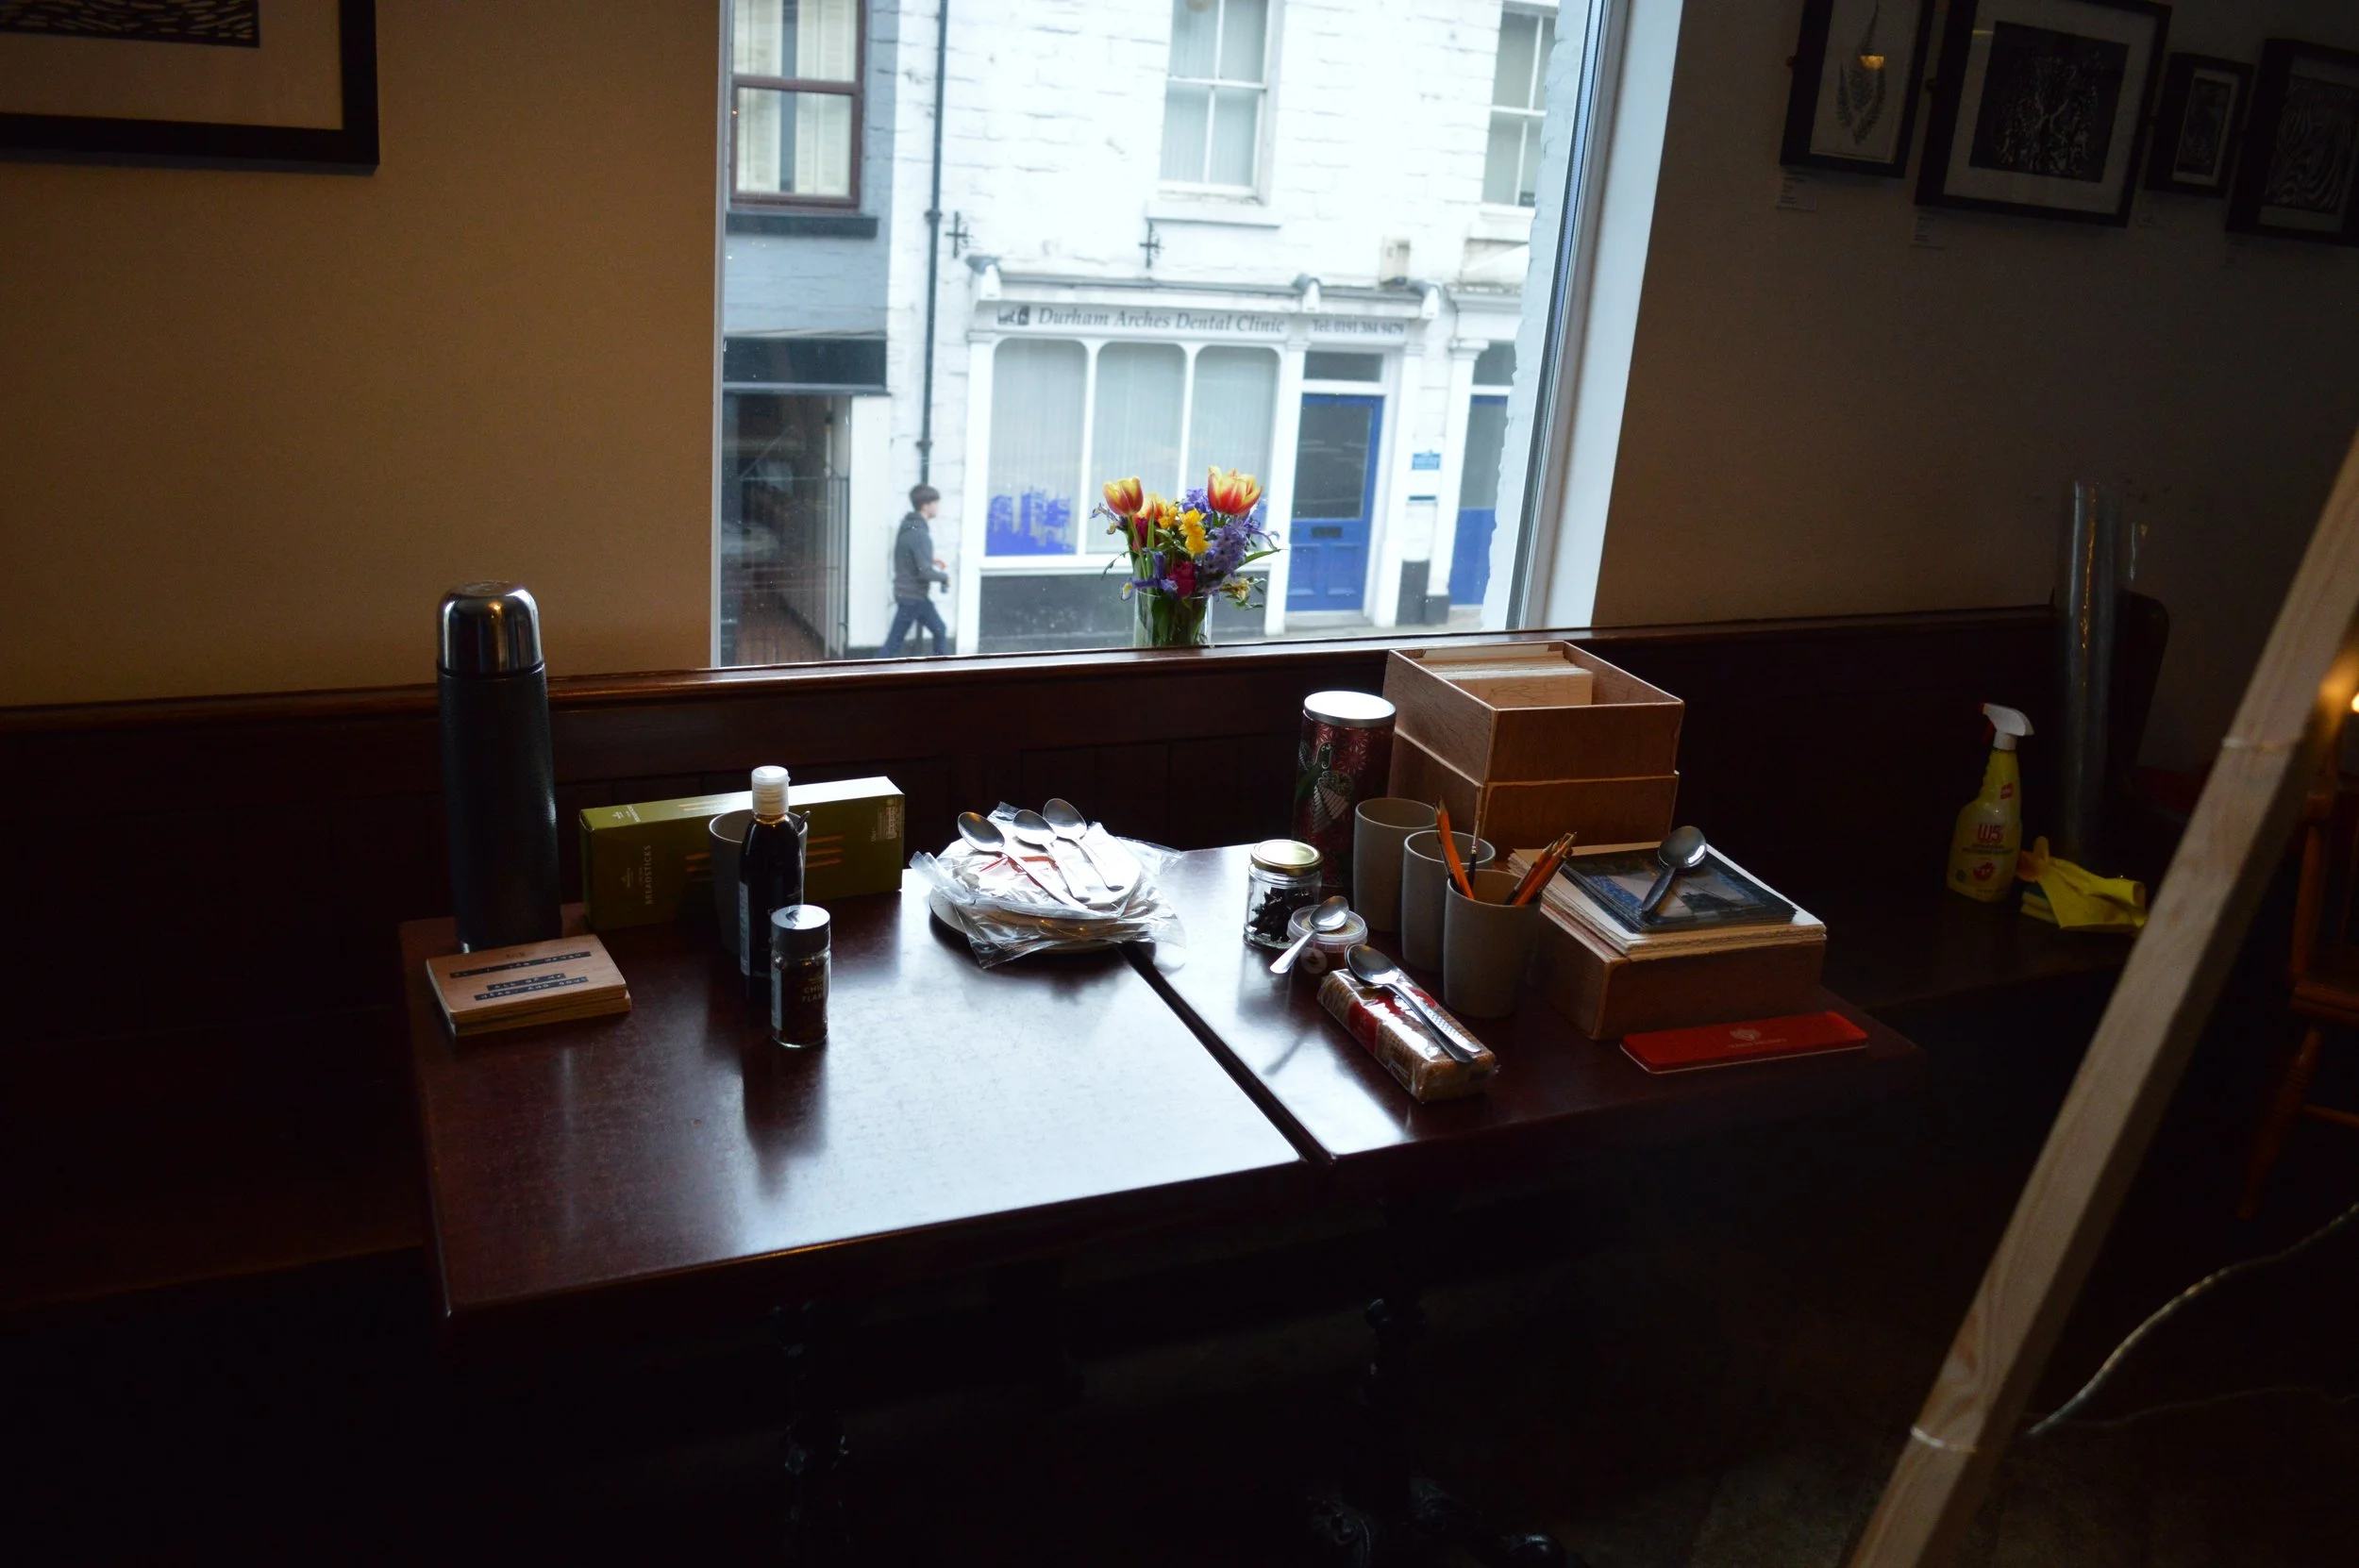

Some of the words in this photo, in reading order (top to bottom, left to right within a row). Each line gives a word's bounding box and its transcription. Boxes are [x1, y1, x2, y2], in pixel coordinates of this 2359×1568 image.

[1038, 307, 1109, 327] Durham
[1113, 309, 1171, 329] Arches
[1176, 311, 1232, 331] Dental
[1237, 313, 1285, 334] Clinic
[1333, 320, 1357, 333] 0191
[1978, 824, 2003, 842] W5
[644, 844, 653, 906] BREADSTICKS
